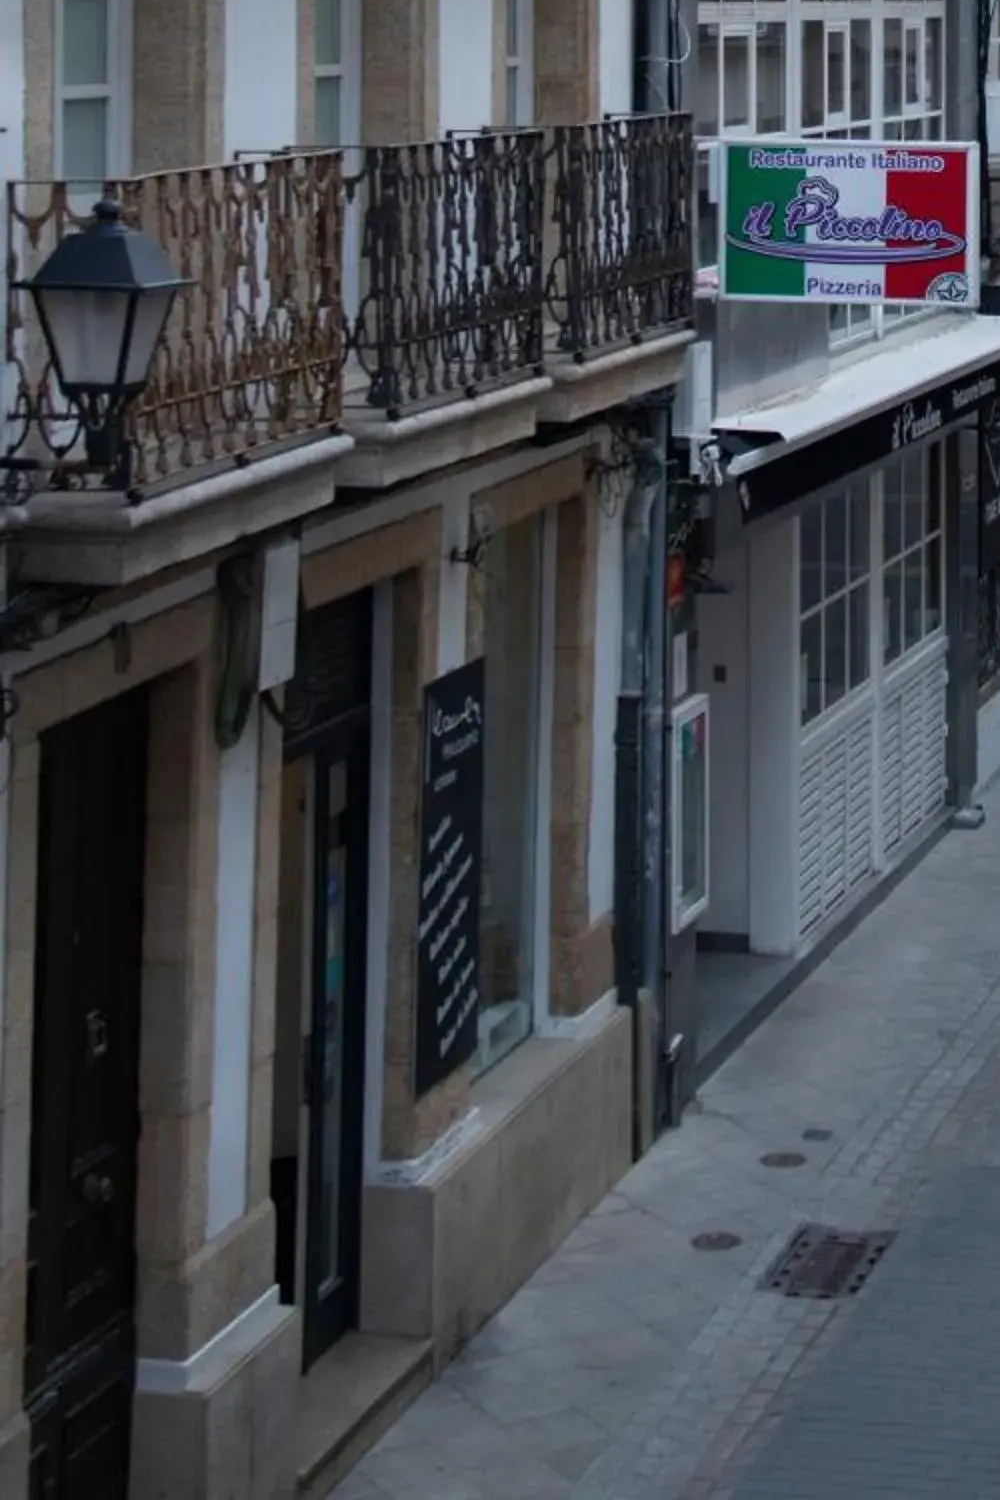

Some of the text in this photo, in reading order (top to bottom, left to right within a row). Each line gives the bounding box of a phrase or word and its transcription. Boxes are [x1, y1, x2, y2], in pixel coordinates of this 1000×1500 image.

[750, 150, 944, 172] Restaurante Italiano
[785, 194, 943, 241] Piccolino
[807, 277, 883, 297] Pizzeria
